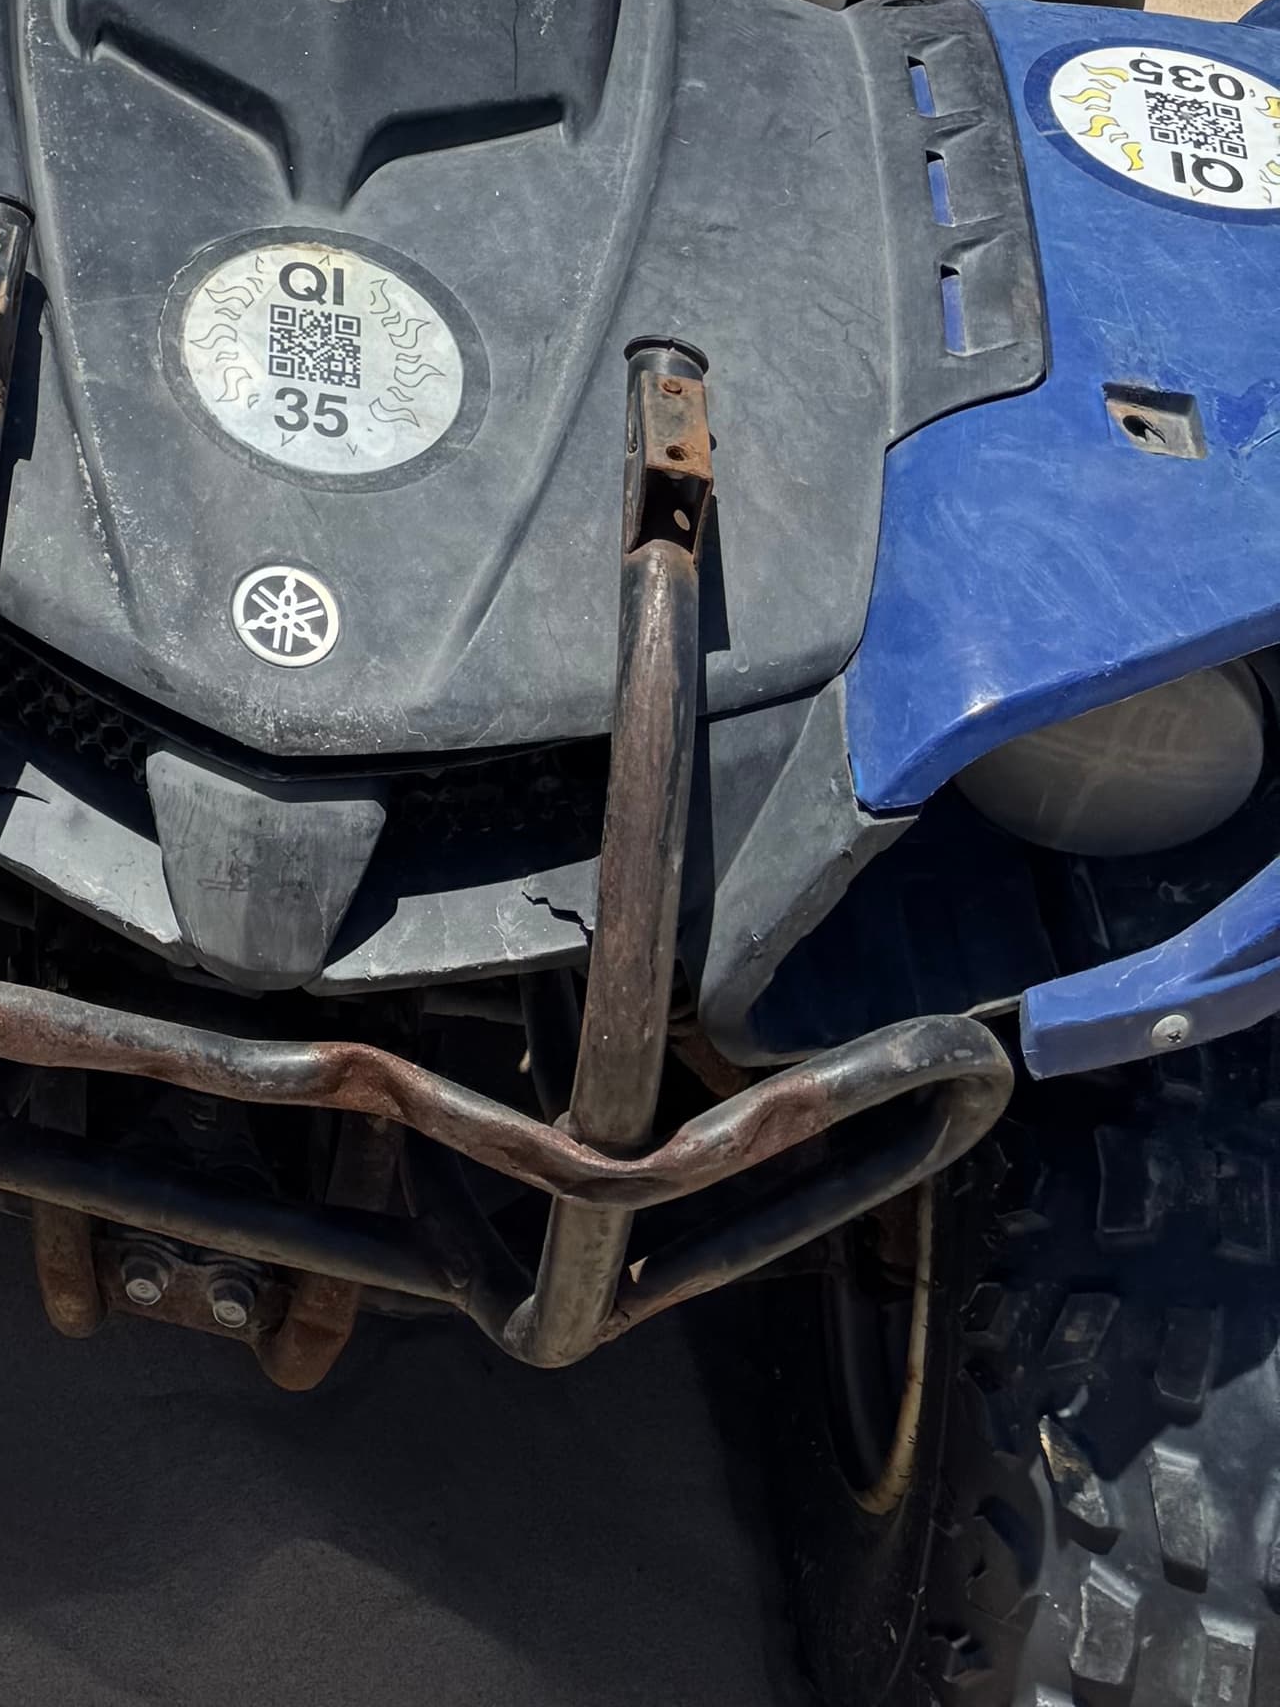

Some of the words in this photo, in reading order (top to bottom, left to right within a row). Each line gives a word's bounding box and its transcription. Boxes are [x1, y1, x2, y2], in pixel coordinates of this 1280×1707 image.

[1128, 58, 1246, 101] 035
[1170, 151, 1244, 193] QI
[278, 261, 345, 306] QI
[273, 387, 349, 439] 35
